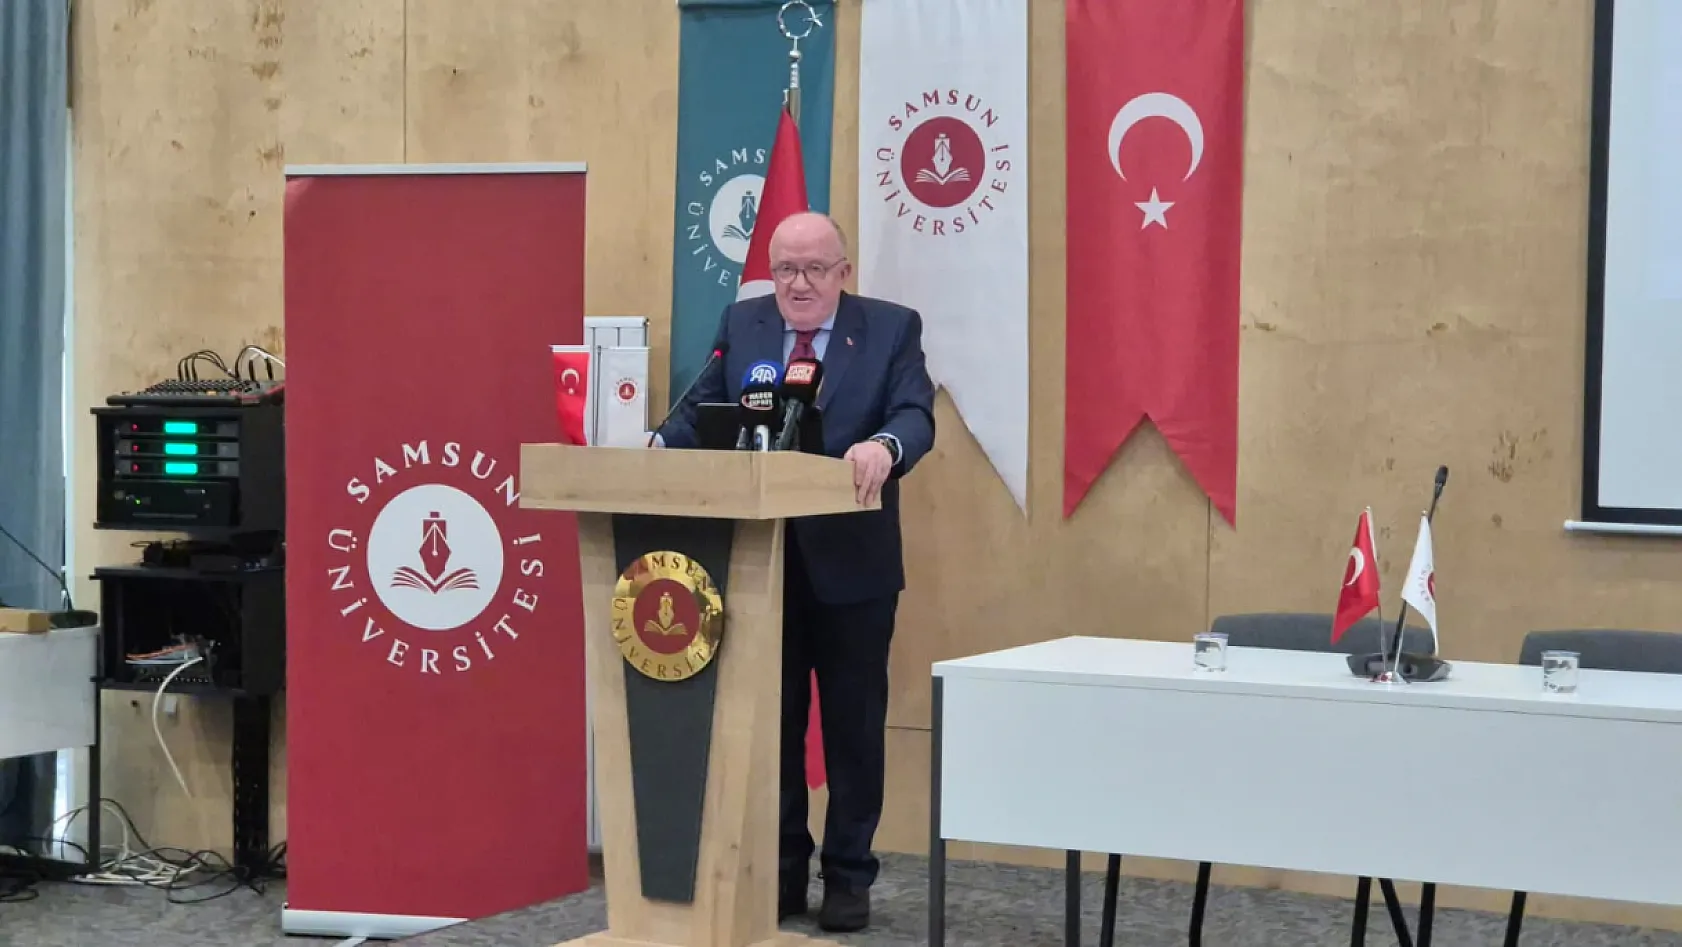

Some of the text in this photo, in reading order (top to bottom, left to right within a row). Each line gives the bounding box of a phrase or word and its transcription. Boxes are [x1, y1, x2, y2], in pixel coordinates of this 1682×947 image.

[888, 88, 999, 131] SAMSUN
[699, 148, 766, 187] SAMS
[876, 144, 1011, 236] ÜNİVERSİTESİ
[347, 440, 521, 506] SAMSUN
[328, 528, 544, 674] ÜNİVERSİTESİ
